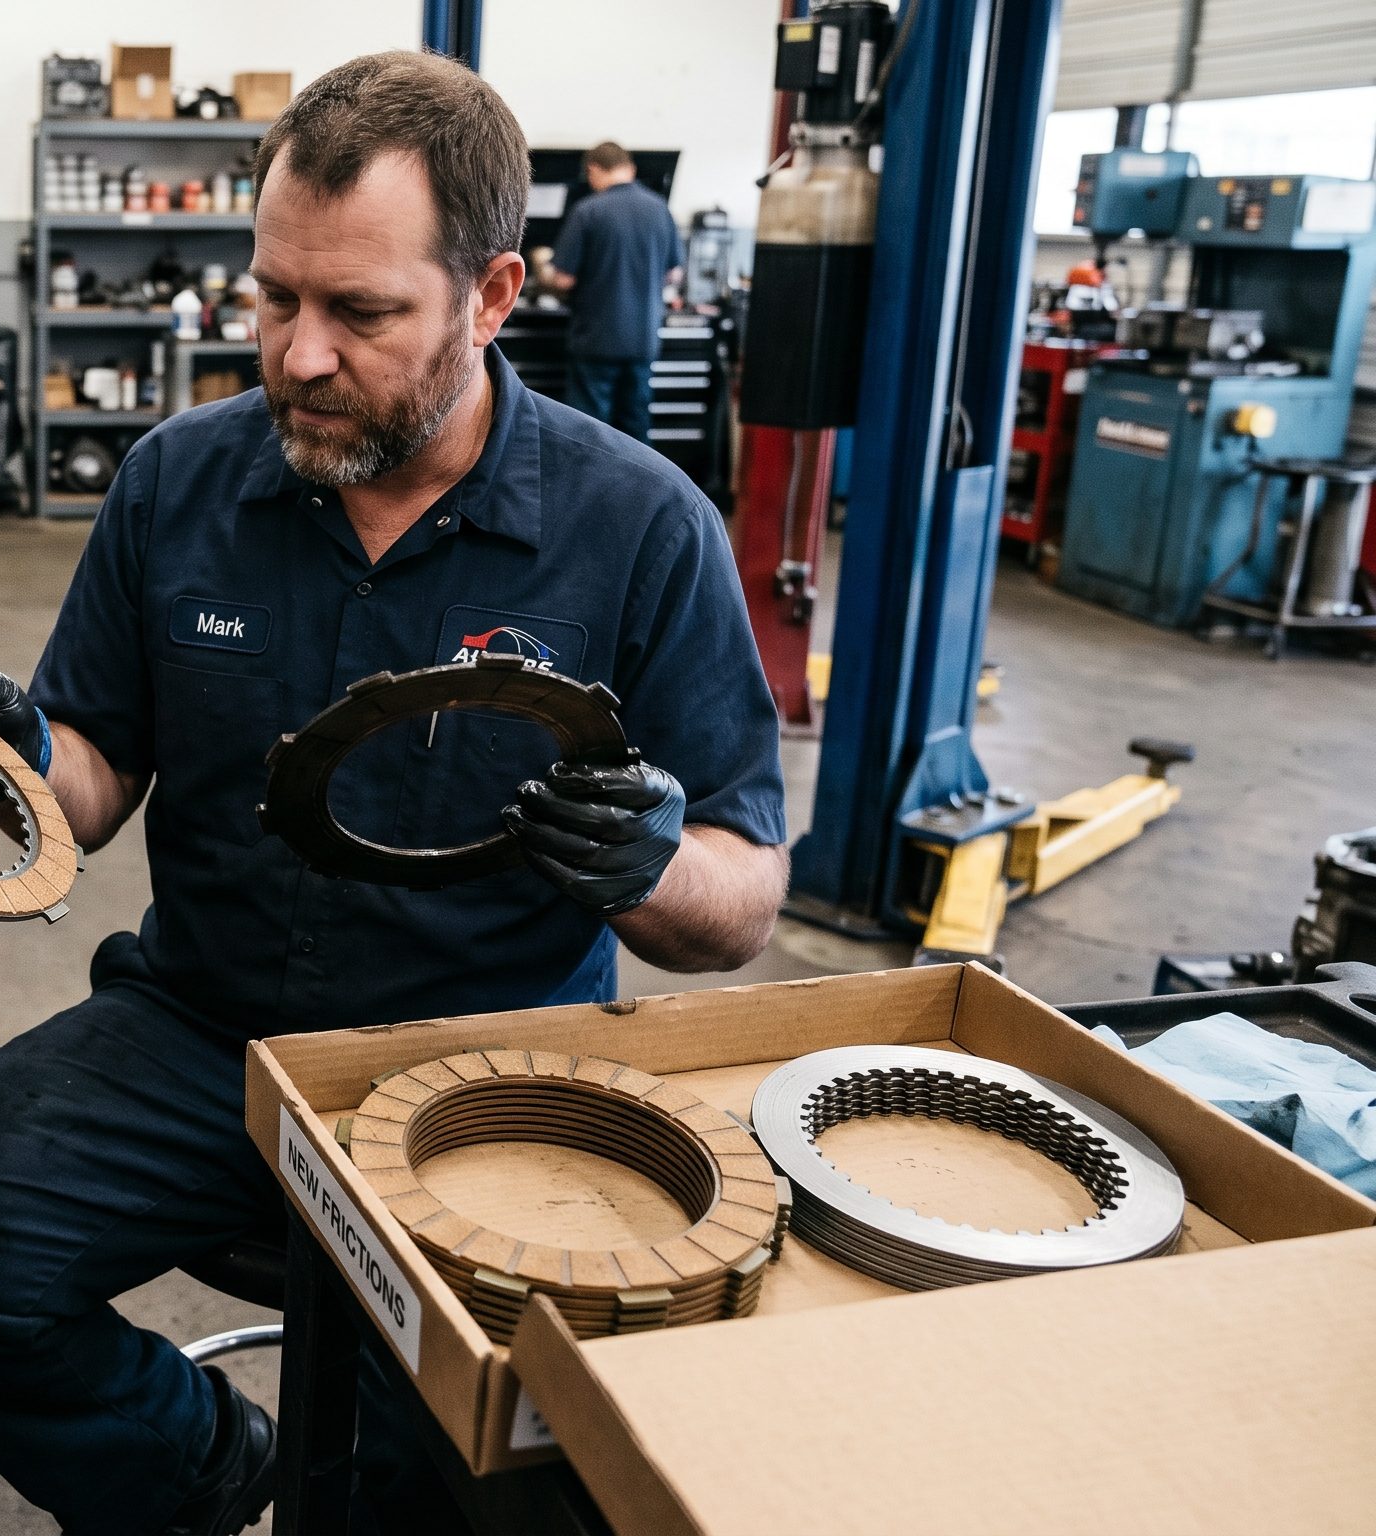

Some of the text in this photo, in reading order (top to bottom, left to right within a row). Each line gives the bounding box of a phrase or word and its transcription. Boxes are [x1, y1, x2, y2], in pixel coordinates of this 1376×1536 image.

[197, 612, 245, 638] Mark
[288, 1137, 406, 1329] NEW FRICTIONS
